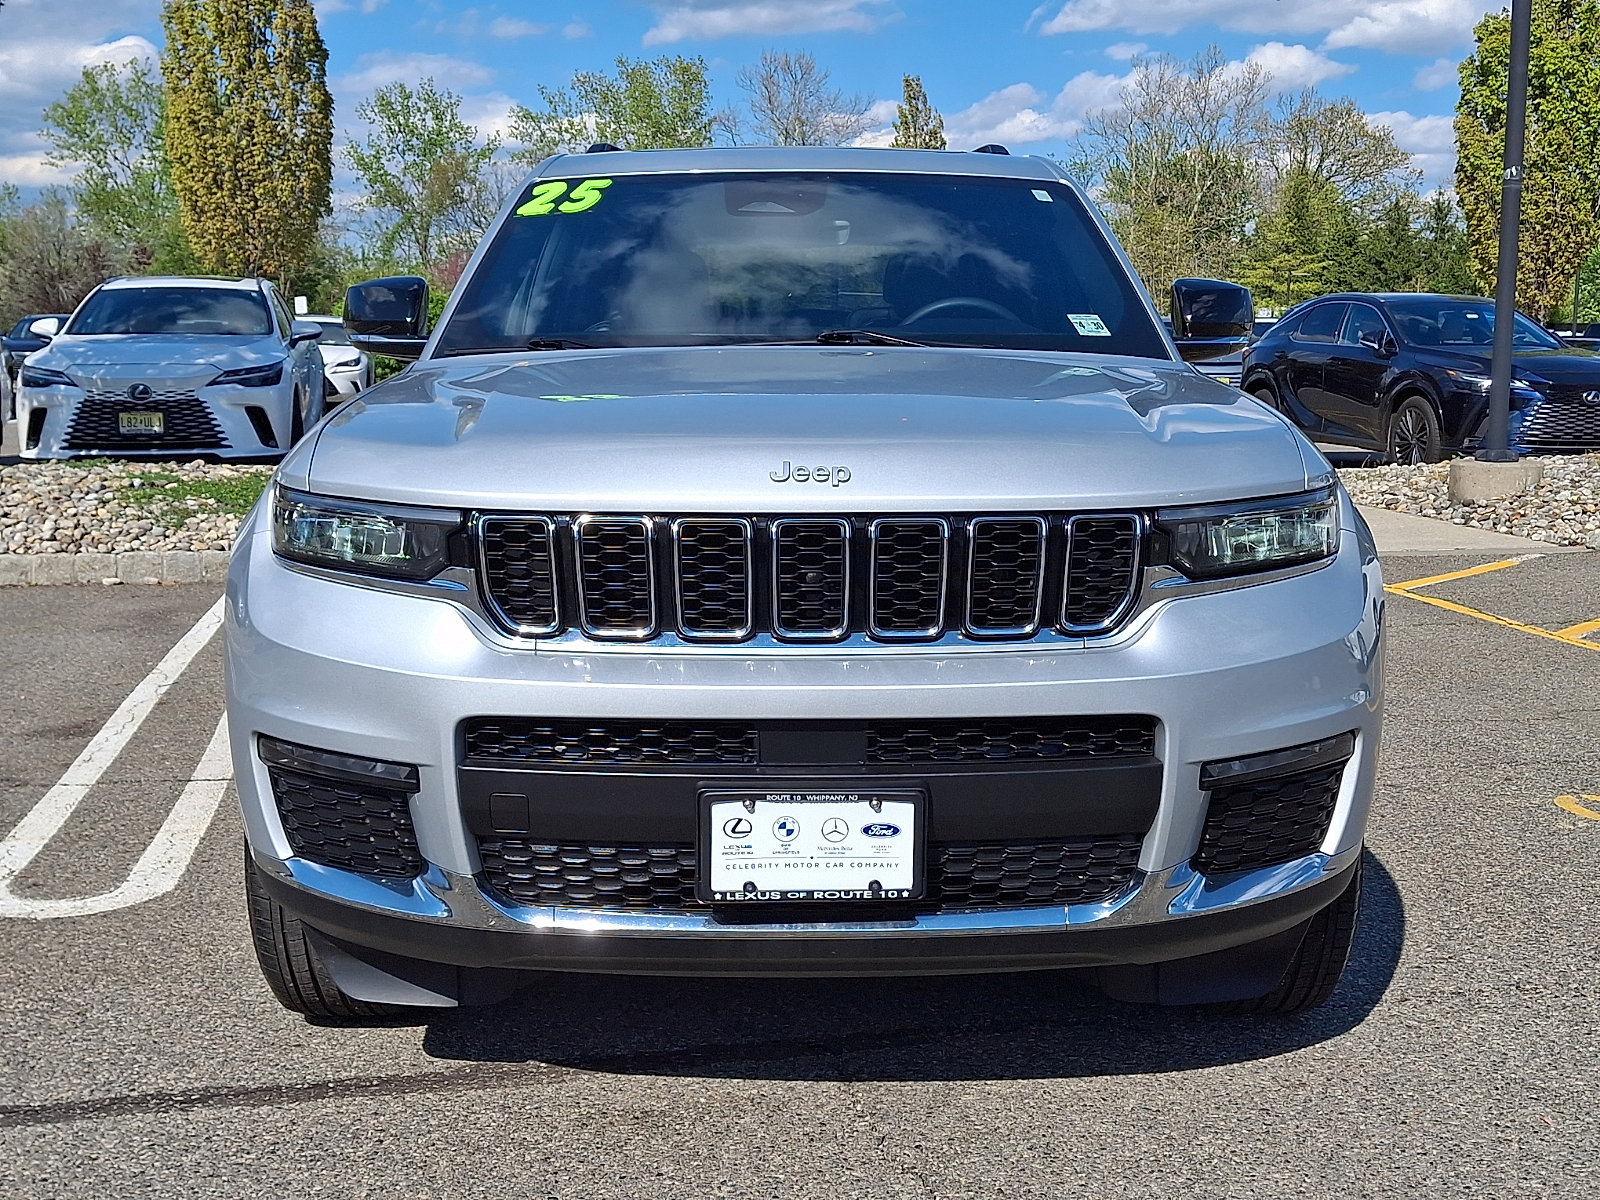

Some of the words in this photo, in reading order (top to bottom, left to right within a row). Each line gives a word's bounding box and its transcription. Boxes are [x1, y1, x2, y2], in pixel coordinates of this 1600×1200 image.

[516, 179, 613, 216] 25
[769, 460, 852, 488] Jeep
[868, 824, 894, 836] Ford
[725, 862, 779, 870] CELEBRITY
[726, 891, 781, 901] LEXUS
[787, 892, 807, 900] OF
[813, 890, 873, 899] ROUTE
[879, 890, 898, 899] 10
